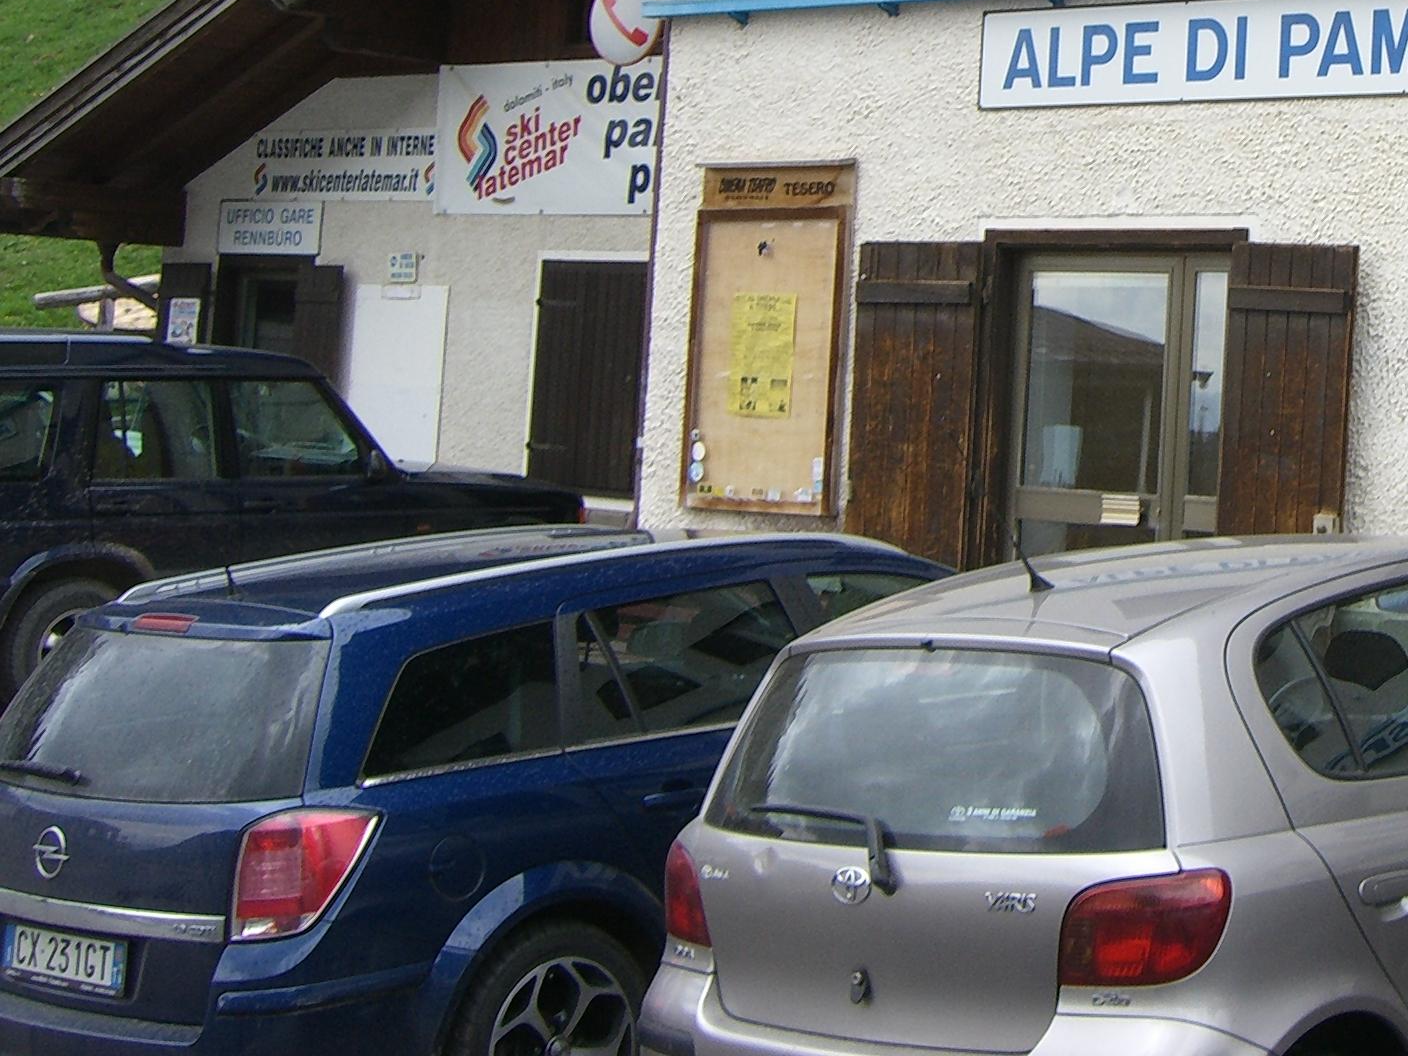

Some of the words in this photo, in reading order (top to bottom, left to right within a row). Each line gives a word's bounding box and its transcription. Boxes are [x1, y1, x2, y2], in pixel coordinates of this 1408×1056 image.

[1002, 20, 1160, 90] ALPE
[1185, 15, 1249, 82] DI
[504, 106, 541, 145] ski
[504, 114, 582, 166] center
[603, 117, 659, 159] pa
[255, 137, 324, 159] CLASSIFICHE
[328, 137, 366, 158] ANCHE
[369, 135, 382, 157] IN
[386, 134, 436, 157] INTERNE
[271, 167, 420, 193] www.skicenterlatemar.it
[476, 143, 569, 200] latemar
[783, 181, 836, 196] TESERO
[226, 208, 275, 225] UFFICIO
[280, 208, 315, 224] GARE
[16, 930, 41, 967] CX
[46, 936, 111, 981] 231GT
